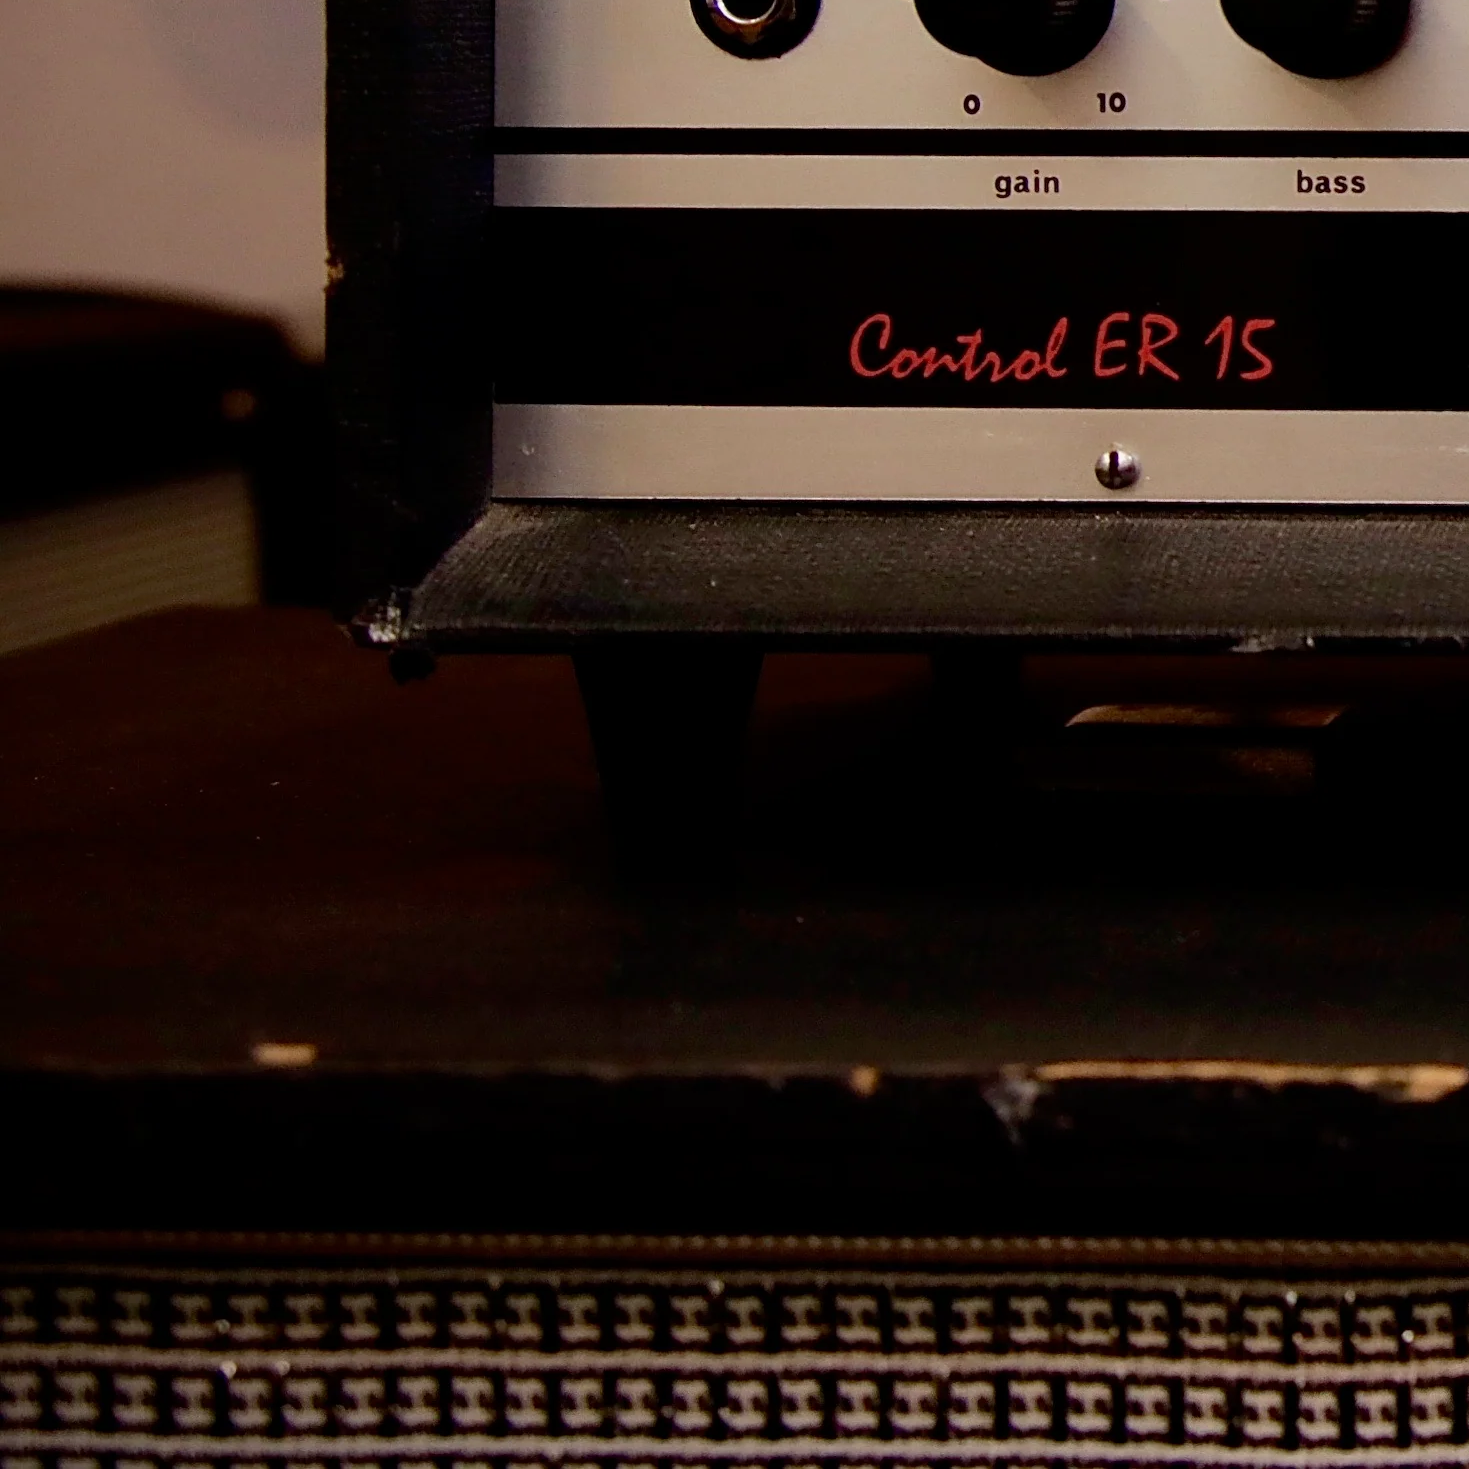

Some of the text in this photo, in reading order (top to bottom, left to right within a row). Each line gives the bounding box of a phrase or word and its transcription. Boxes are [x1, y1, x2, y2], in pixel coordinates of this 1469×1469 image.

[963, 93, 981, 115] 0
[1096, 91, 1127, 114] 10
[994, 169, 1060, 199] gain
[1296, 169, 1366, 194] bass
[849, 311, 1276, 383] Control ER 15
